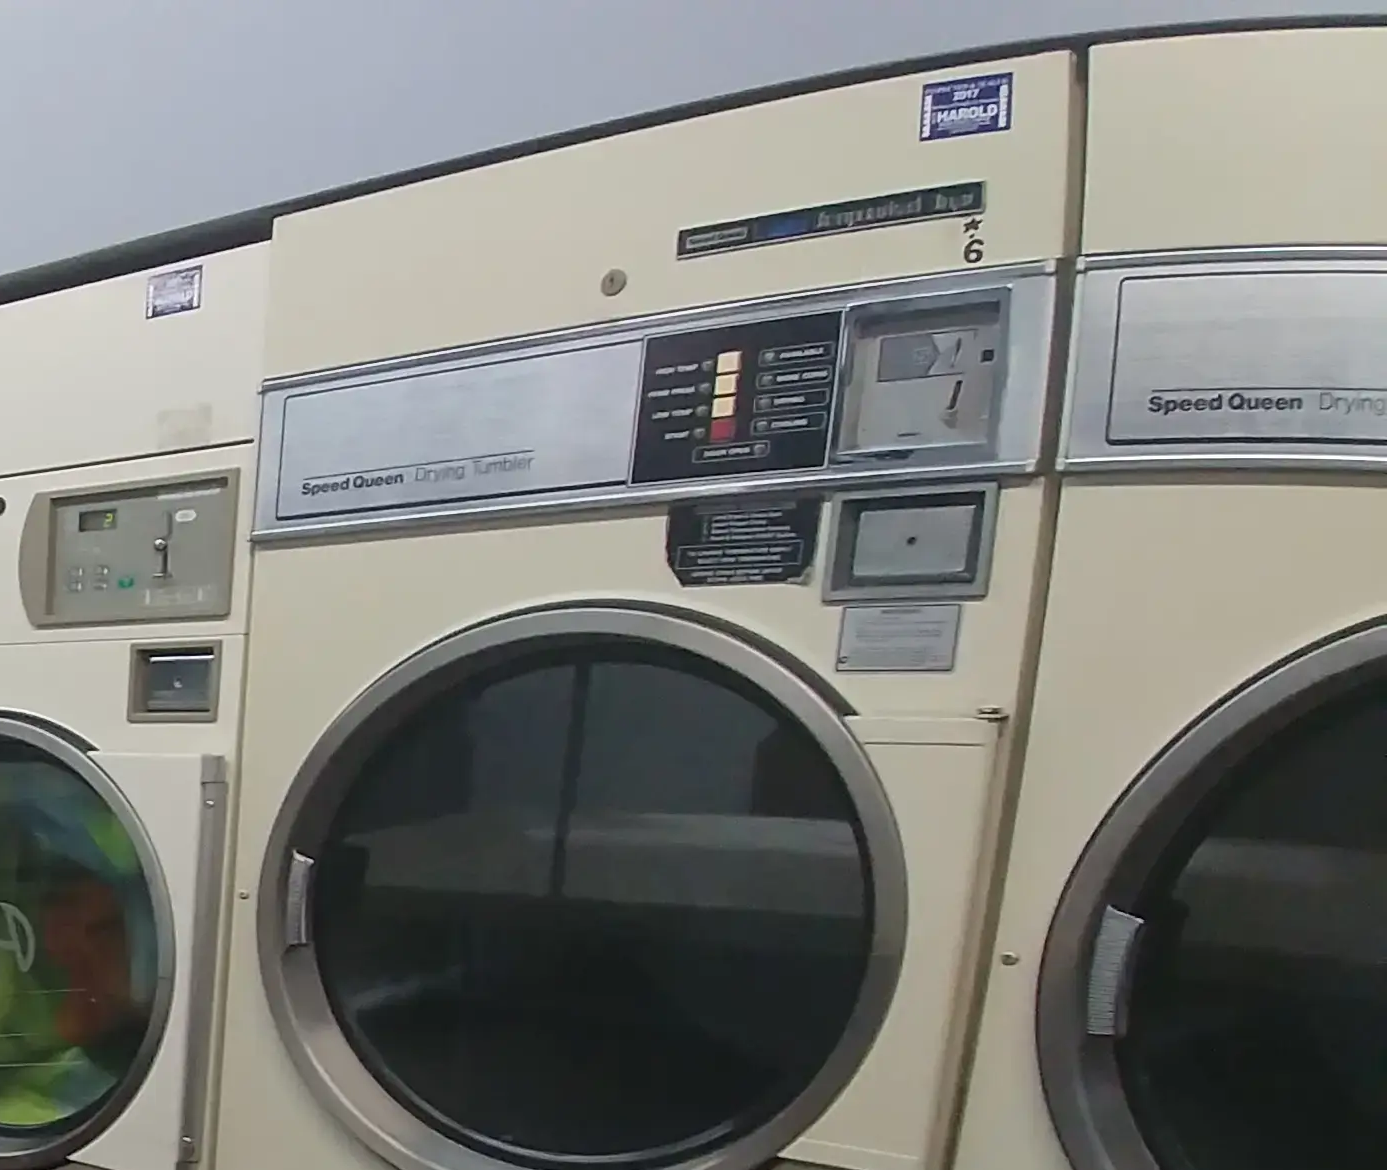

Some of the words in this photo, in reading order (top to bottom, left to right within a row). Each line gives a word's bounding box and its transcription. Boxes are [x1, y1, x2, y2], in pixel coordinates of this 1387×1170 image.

[937, 103, 998, 123] HAROLD
[963, 238, 984, 263] 6
[1148, 393, 1223, 415] Speed
[1228, 392, 1303, 411] Queen
[1319, 392, 1387, 415] Drying
[301, 476, 350, 496] Speed
[353, 472, 404, 490] Queen
[414, 465, 465, 484] Drying
[472, 454, 535, 476] Tumbler
